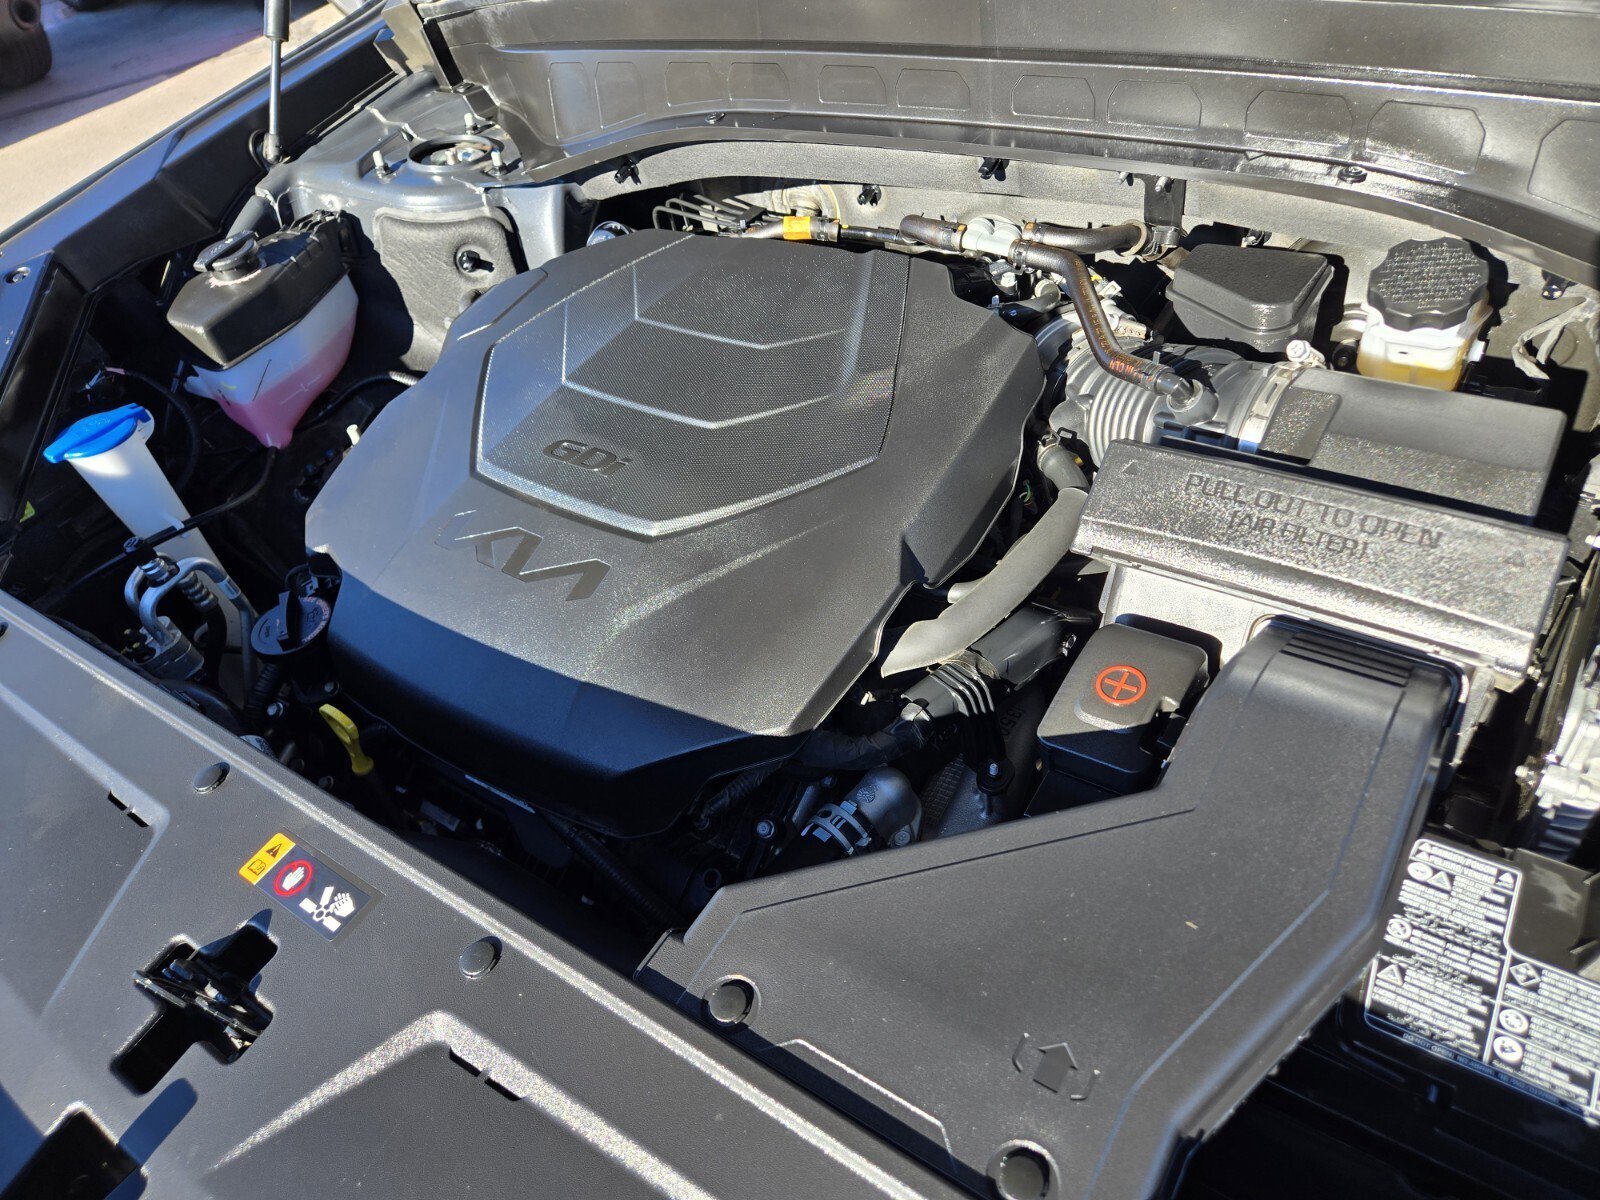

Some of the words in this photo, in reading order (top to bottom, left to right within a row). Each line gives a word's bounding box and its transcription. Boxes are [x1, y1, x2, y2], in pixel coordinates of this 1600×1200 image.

[543, 439, 632, 477] GDi
[1185, 473, 1247, 507] PULL
[1255, 488, 1306, 516] OUT
[1312, 502, 1354, 528] TO
[1358, 513, 1442, 551] OPEN
